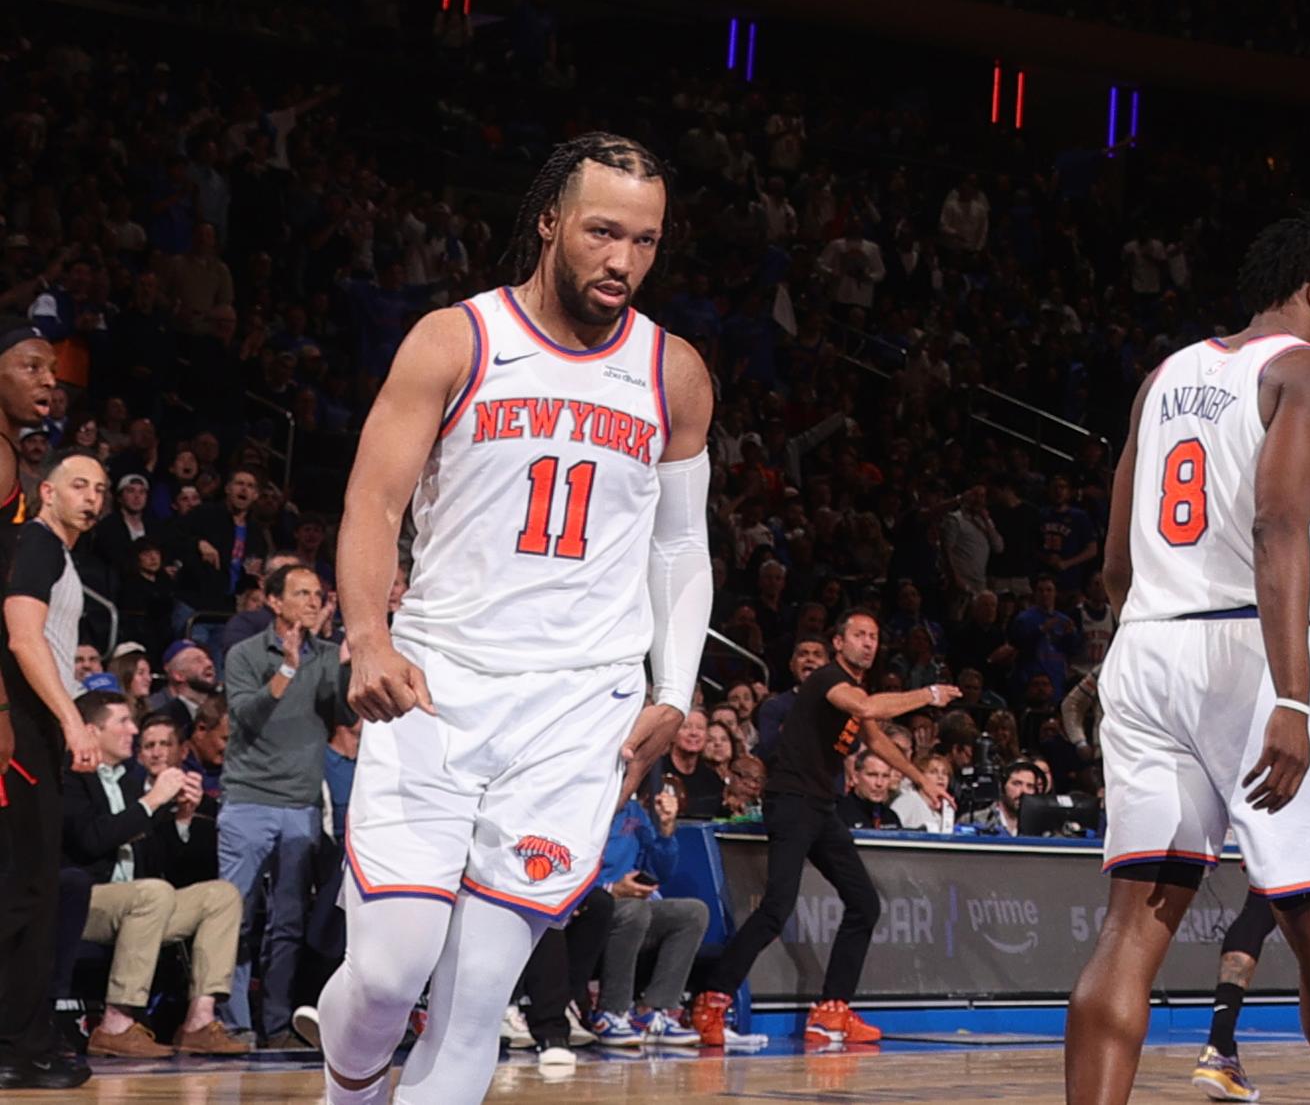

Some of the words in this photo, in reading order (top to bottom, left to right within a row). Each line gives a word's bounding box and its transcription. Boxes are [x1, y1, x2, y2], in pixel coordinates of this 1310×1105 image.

[472, 397, 565, 445] NEW
[567, 398, 660, 466] YORK
[515, 455, 597, 561] 11
[1158, 437, 1208, 547] 8
[796, 896, 935, 945] NACAR
[966, 892, 1040, 931] prime
